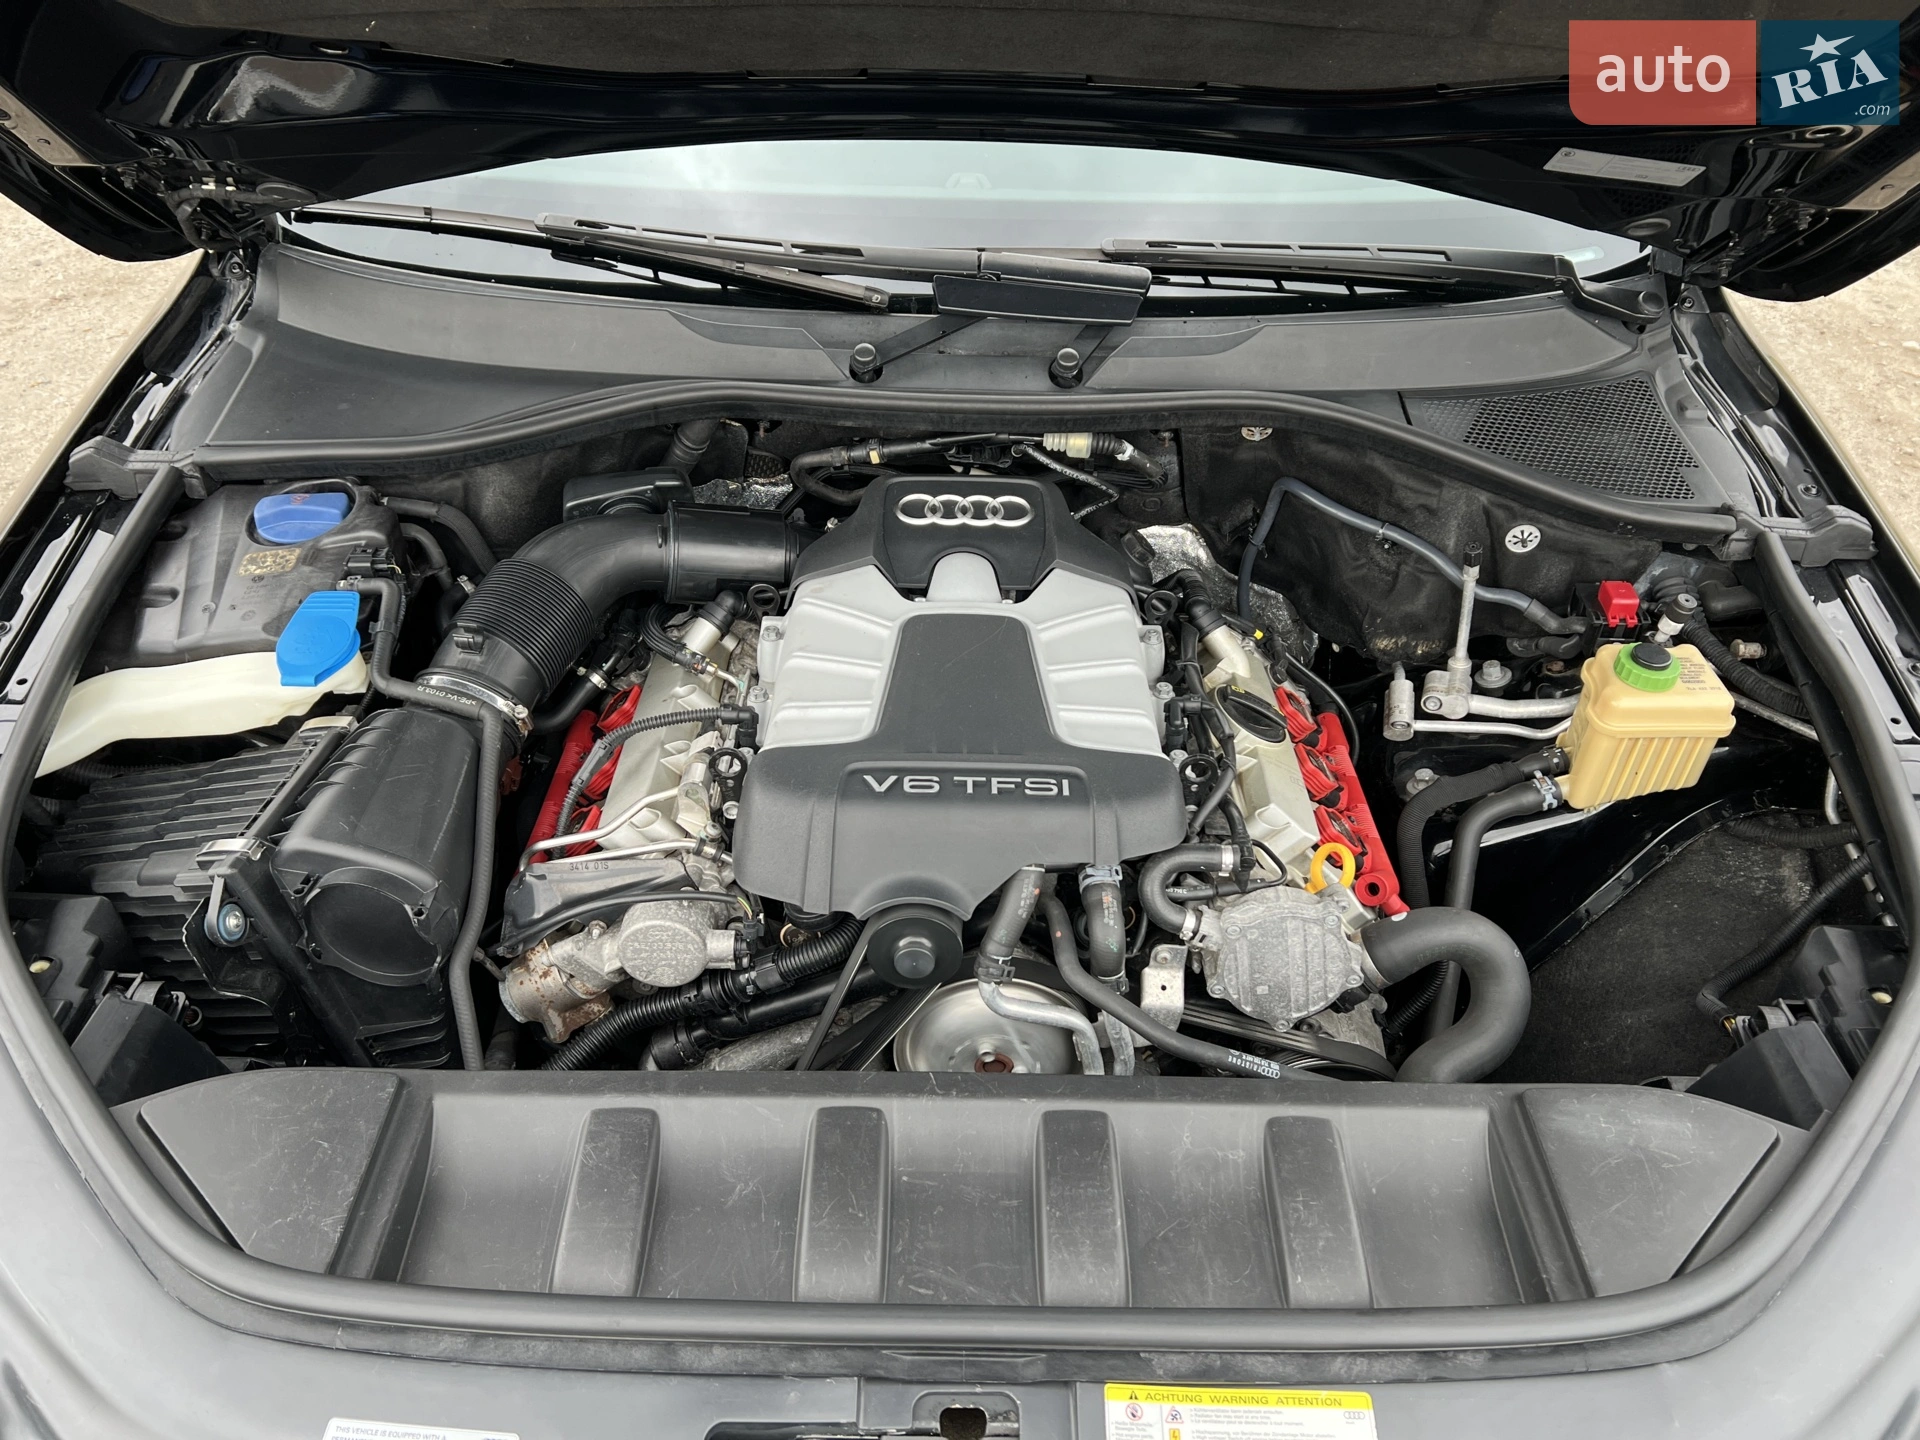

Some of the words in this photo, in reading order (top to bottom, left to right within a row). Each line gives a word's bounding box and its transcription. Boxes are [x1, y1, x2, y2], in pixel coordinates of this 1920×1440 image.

[863, 774, 941, 794] V6
[953, 776, 1071, 797] TFSI
[569, 862, 590, 871] 3414
[1145, 1391, 1203, 1404] ACHTUNG
[1210, 1395, 1269, 1405] WARNING
[1276, 1396, 1342, 1407] ATTENTION
[335, 1425, 351, 1434] THIS
[352, 1427, 379, 1436] VEHICLE
[388, 1430, 421, 1439] EQUIPPED
